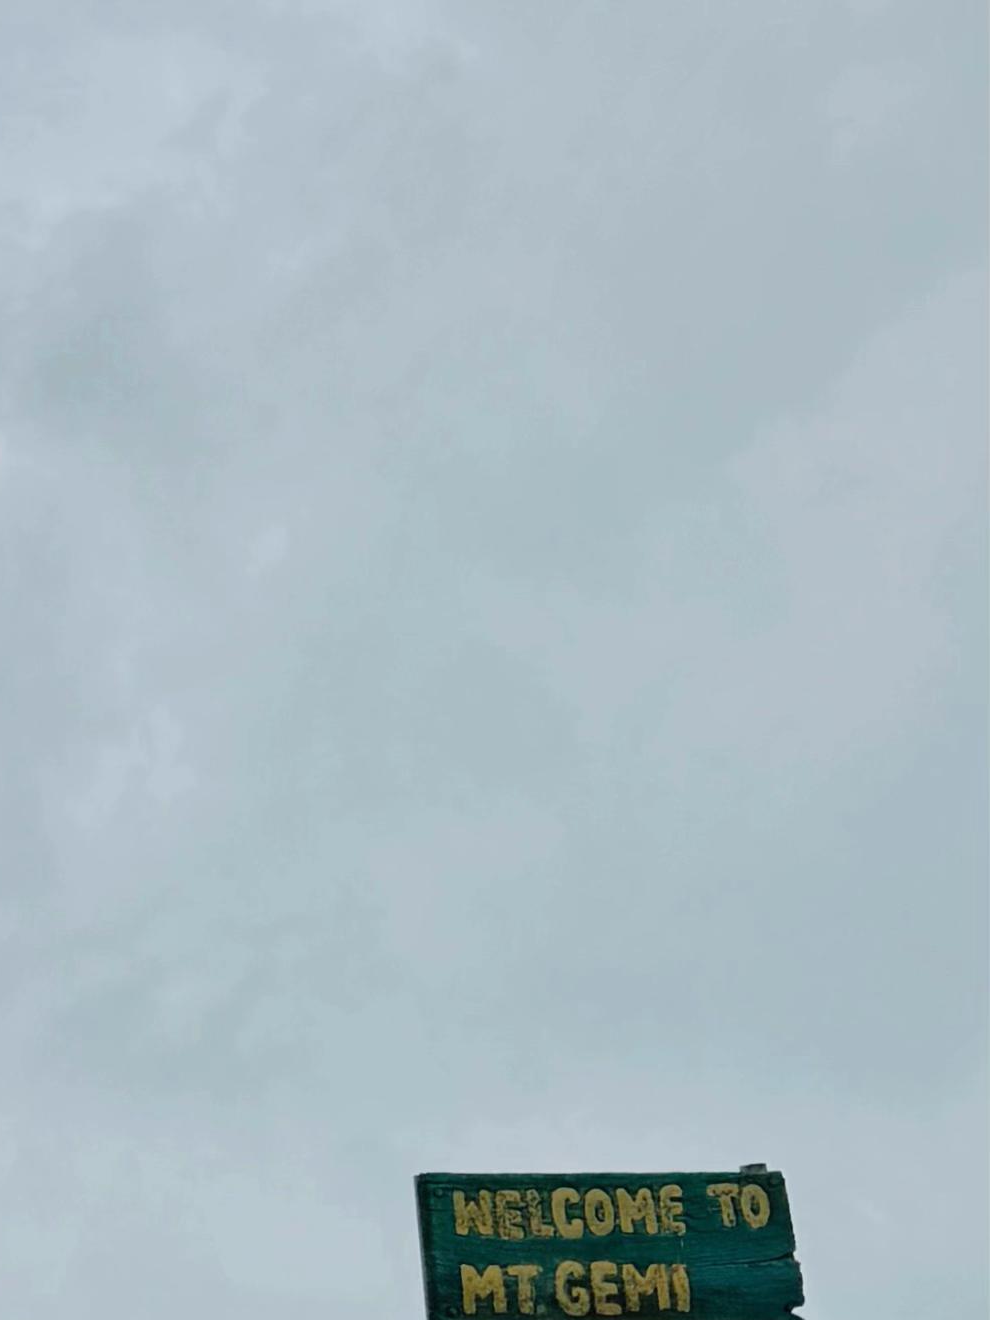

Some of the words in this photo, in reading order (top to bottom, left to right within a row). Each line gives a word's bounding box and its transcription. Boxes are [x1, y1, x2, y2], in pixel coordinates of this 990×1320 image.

[452, 1183, 687, 1240] WELCOME
[705, 1182, 771, 1230] TO
[554, 1260, 691, 1317] GEMI
